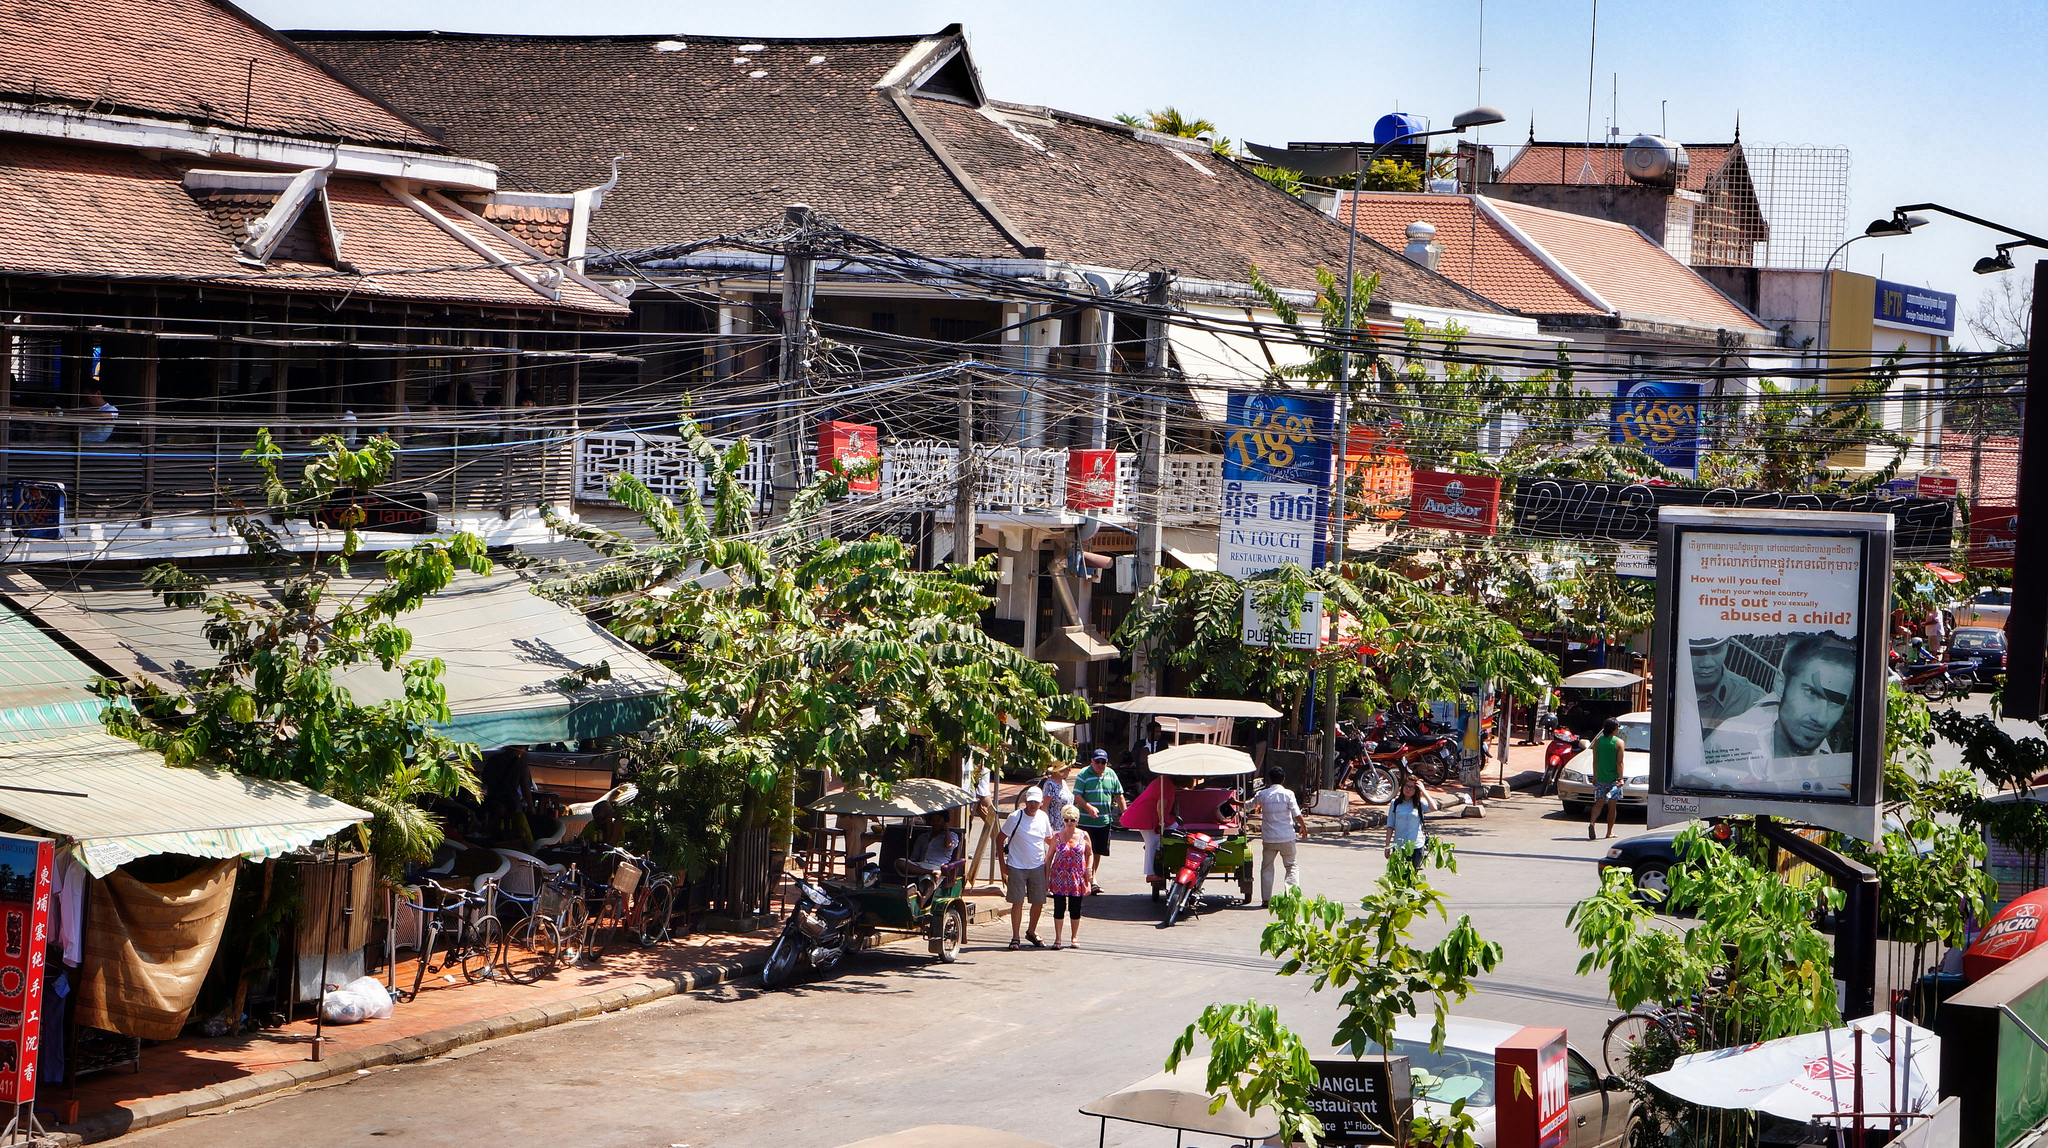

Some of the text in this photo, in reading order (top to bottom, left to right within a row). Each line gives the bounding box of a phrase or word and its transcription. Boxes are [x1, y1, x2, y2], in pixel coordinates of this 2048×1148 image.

[1616, 399, 1696, 443] Tiger
[1228, 406, 1316, 471] Tiger
[364, 497, 422, 525] Piano
[1421, 497, 1483, 517] Angkor
[1518, 481, 1655, 545] PUB
[1230, 529, 1300, 548] IN TOUCH
[1230, 551, 1300, 565] RESTAURANT & BAR
[1616, 560, 1631, 570] plus
[1241, 566, 1260, 575] LIVE
[1690, 574, 1781, 587] How will you feel
[1699, 594, 1736, 607] finds
[1741, 597, 1768, 608] out
[1789, 600, 1819, 608] sexually
[1778, 590, 1808, 598] country
[1720, 608, 1852, 625] abused a child?
[1247, 630, 1271, 642] PUB
[1672, 796, 1690, 804] PPML
[1664, 804, 1698, 812] SCOM-02
[1540, 1058, 1566, 1123] ATM
[1307, 1098, 1378, 1114] estaurant
[1355, 1121, 1376, 1130] Floo
